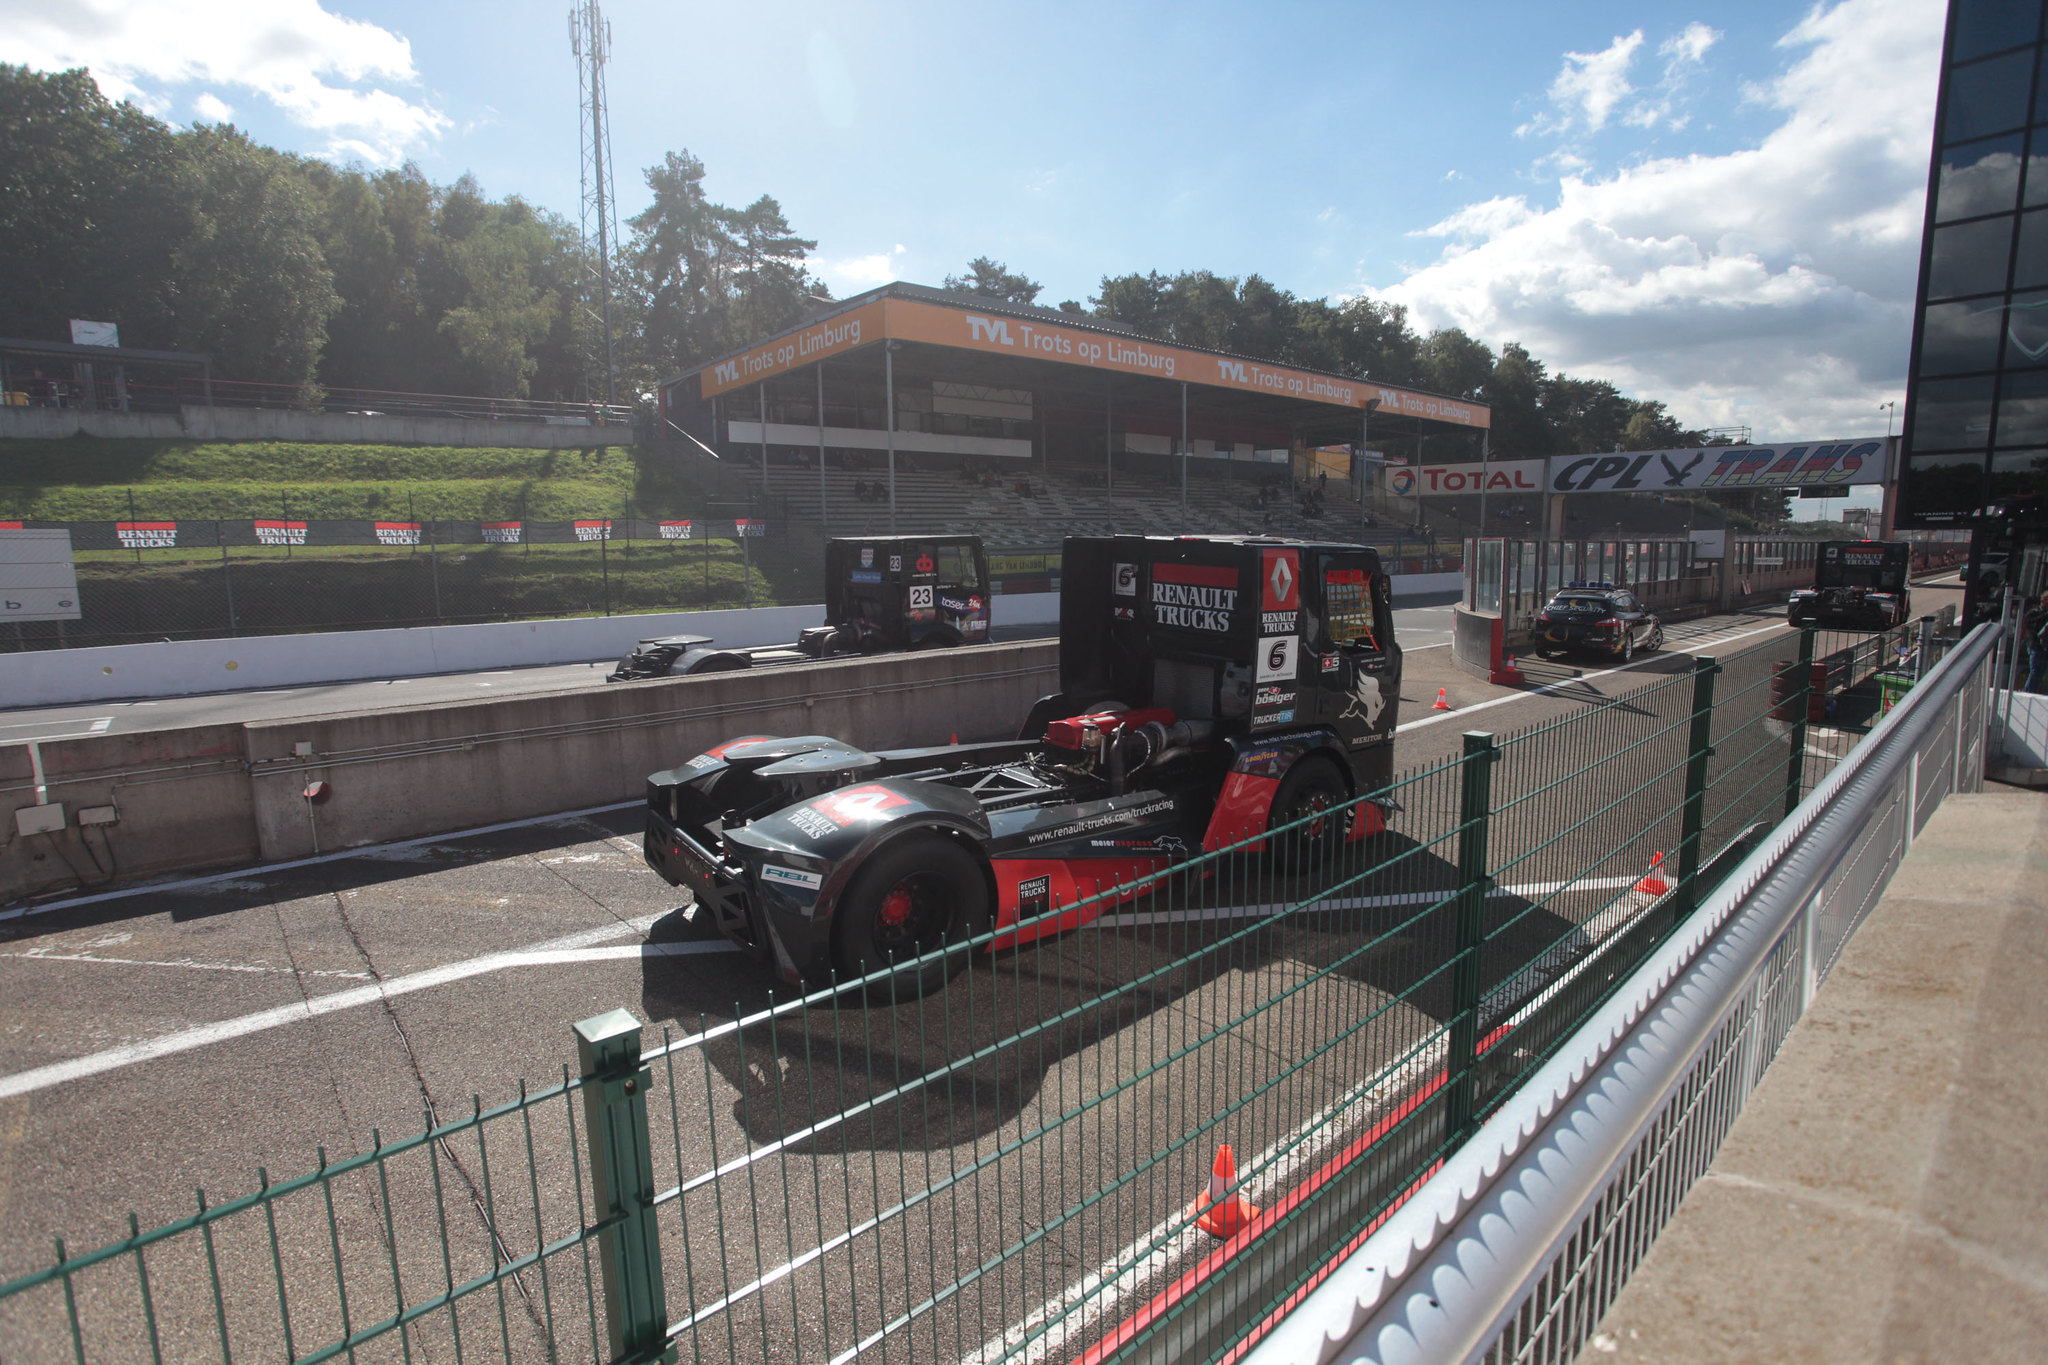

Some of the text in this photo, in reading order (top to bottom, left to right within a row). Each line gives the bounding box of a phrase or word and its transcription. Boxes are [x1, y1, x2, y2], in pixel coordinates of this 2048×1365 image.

[715, 320, 861, 385] TVL Trots op Limburg
[966, 315, 1175, 376] TVL Trots op Limburg
[1218, 360, 1351, 404] TVL Trots op Limburg
[1402, 394, 1423, 412] Trots
[1426, 401, 1437, 416] op
[1439, 401, 1470, 424] Limburg
[1553, 442, 1882, 491] CPL TRANS
[1423, 469, 1535, 491] TOTAL
[118, 530, 178, 539] RENAULT
[255, 528, 307, 537] RENAULT
[259, 536, 306, 545] TRUCKS
[484, 535, 520, 543] TRUCKS
[121, 539, 176, 548] TRUCKS
[890, 557, 900, 570] 23
[912, 588, 931, 605] 23
[1152, 582, 1238, 610] RENAULT
[1262, 611, 1298, 623] RENAULT
[1569, 605, 1606, 614] SECURITY
[1154, 604, 1230, 632] TRUCKS
[1263, 621, 1295, 633] TRUCKS
[1267, 640, 1288, 671] 6
[1255, 692, 1296, 705] bösiger
[1352, 733, 1383, 745] MERITOR
[787, 814, 825, 840] TRUCKS
[796, 807, 839, 835] RENAULT
[1028, 800, 1174, 844] www.renault-trucks.com/truckracing
[765, 868, 817, 884] RBL
[1020, 878, 1046, 892] RENAULT
[1020, 885, 1046, 899] TRUCKS
